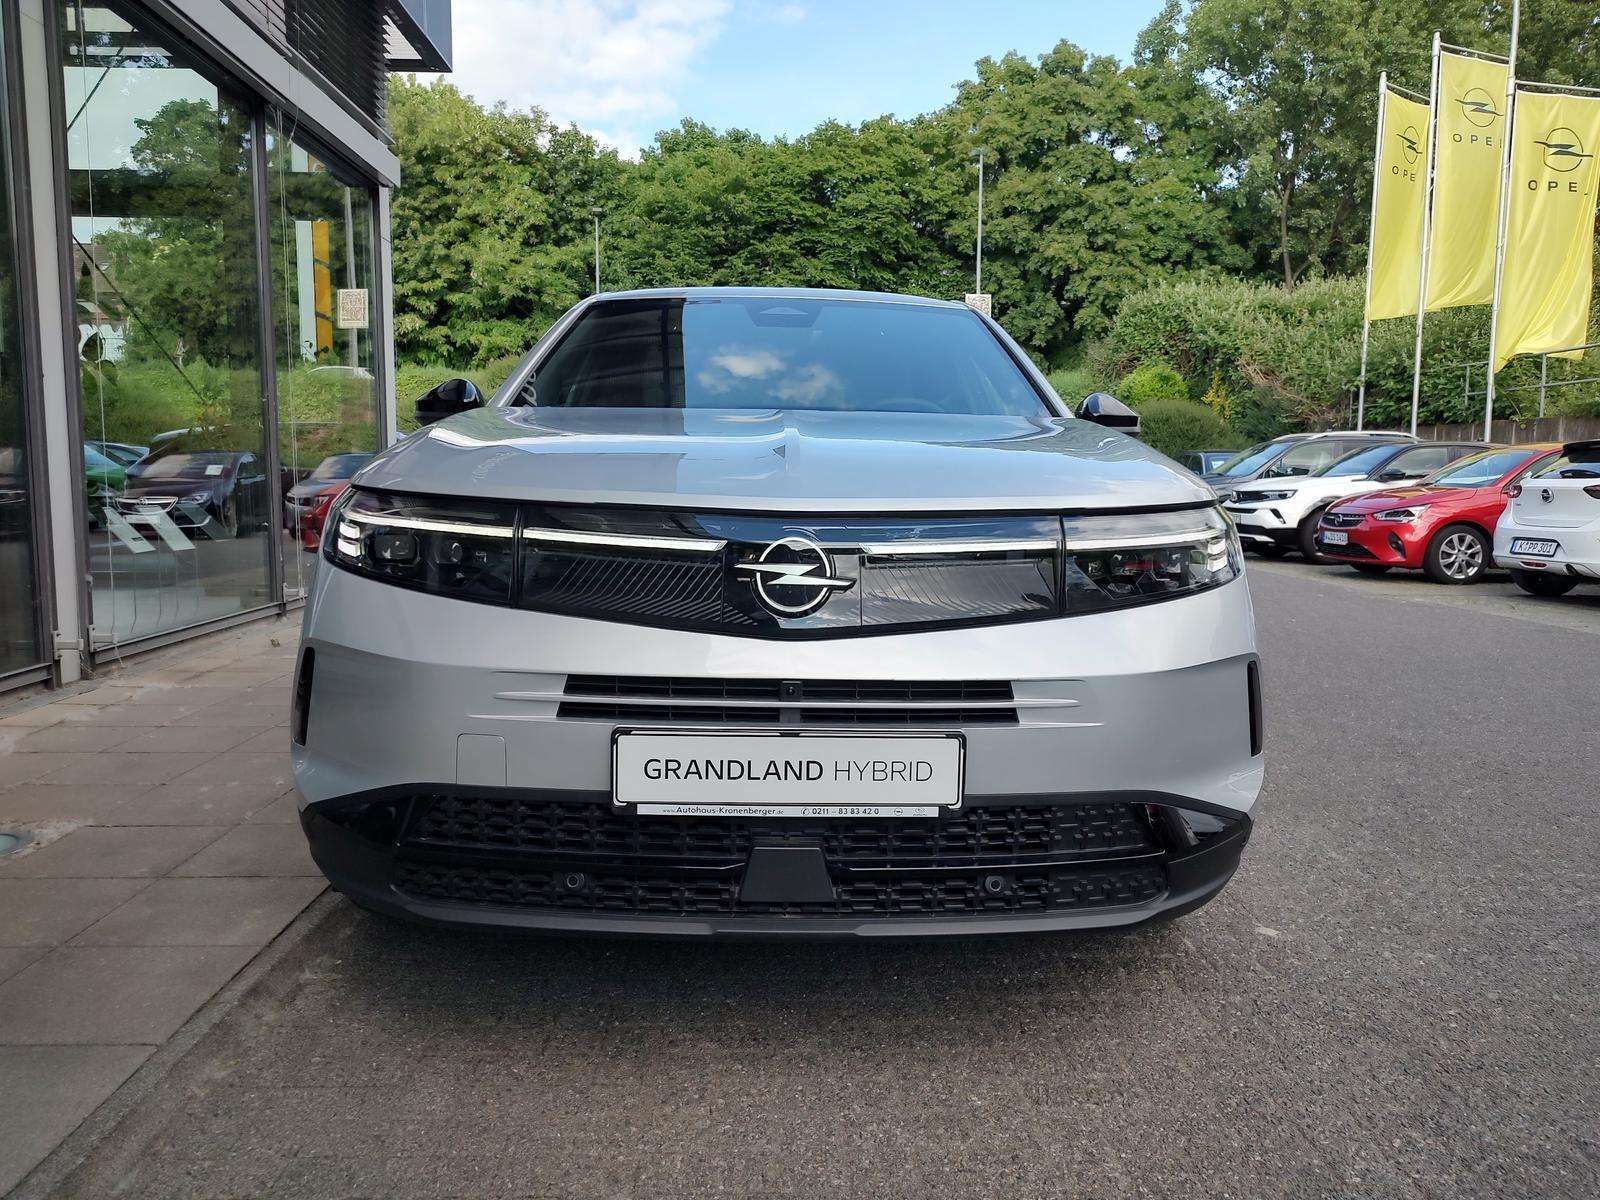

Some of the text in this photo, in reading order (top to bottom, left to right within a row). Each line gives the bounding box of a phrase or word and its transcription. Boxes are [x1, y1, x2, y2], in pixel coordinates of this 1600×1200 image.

[1453, 133, 1501, 148] OPE
[1391, 165, 1416, 181] OPE
[1527, 179, 1588, 195] OPE
[643, 758, 933, 782] GRANDLAND HYBRID
